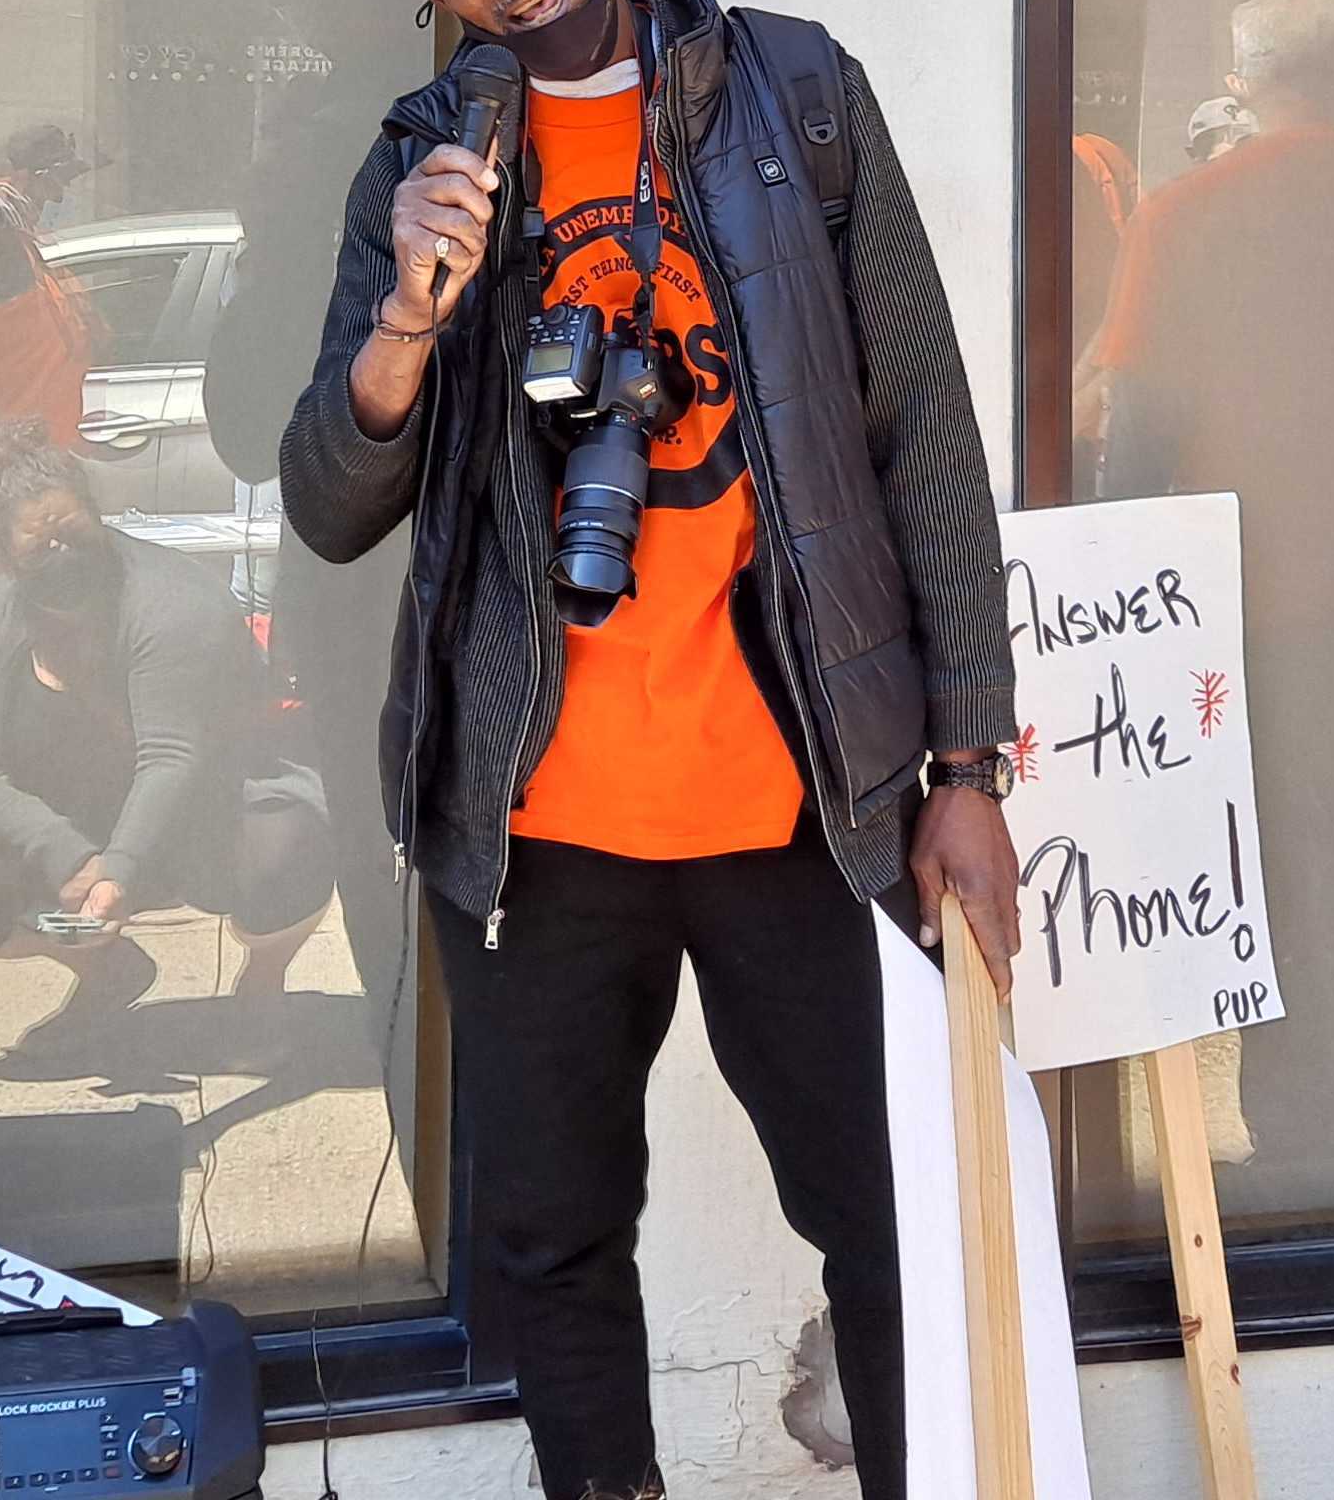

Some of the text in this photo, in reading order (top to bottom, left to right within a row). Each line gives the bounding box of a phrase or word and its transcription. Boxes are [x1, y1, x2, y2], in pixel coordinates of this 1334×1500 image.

[638, 161, 651, 204] EOS
[1214, 981, 1269, 1028] PUP
[29, 1400, 76, 1414] ROCKER
[77, 1397, 107, 1410] PLUS
